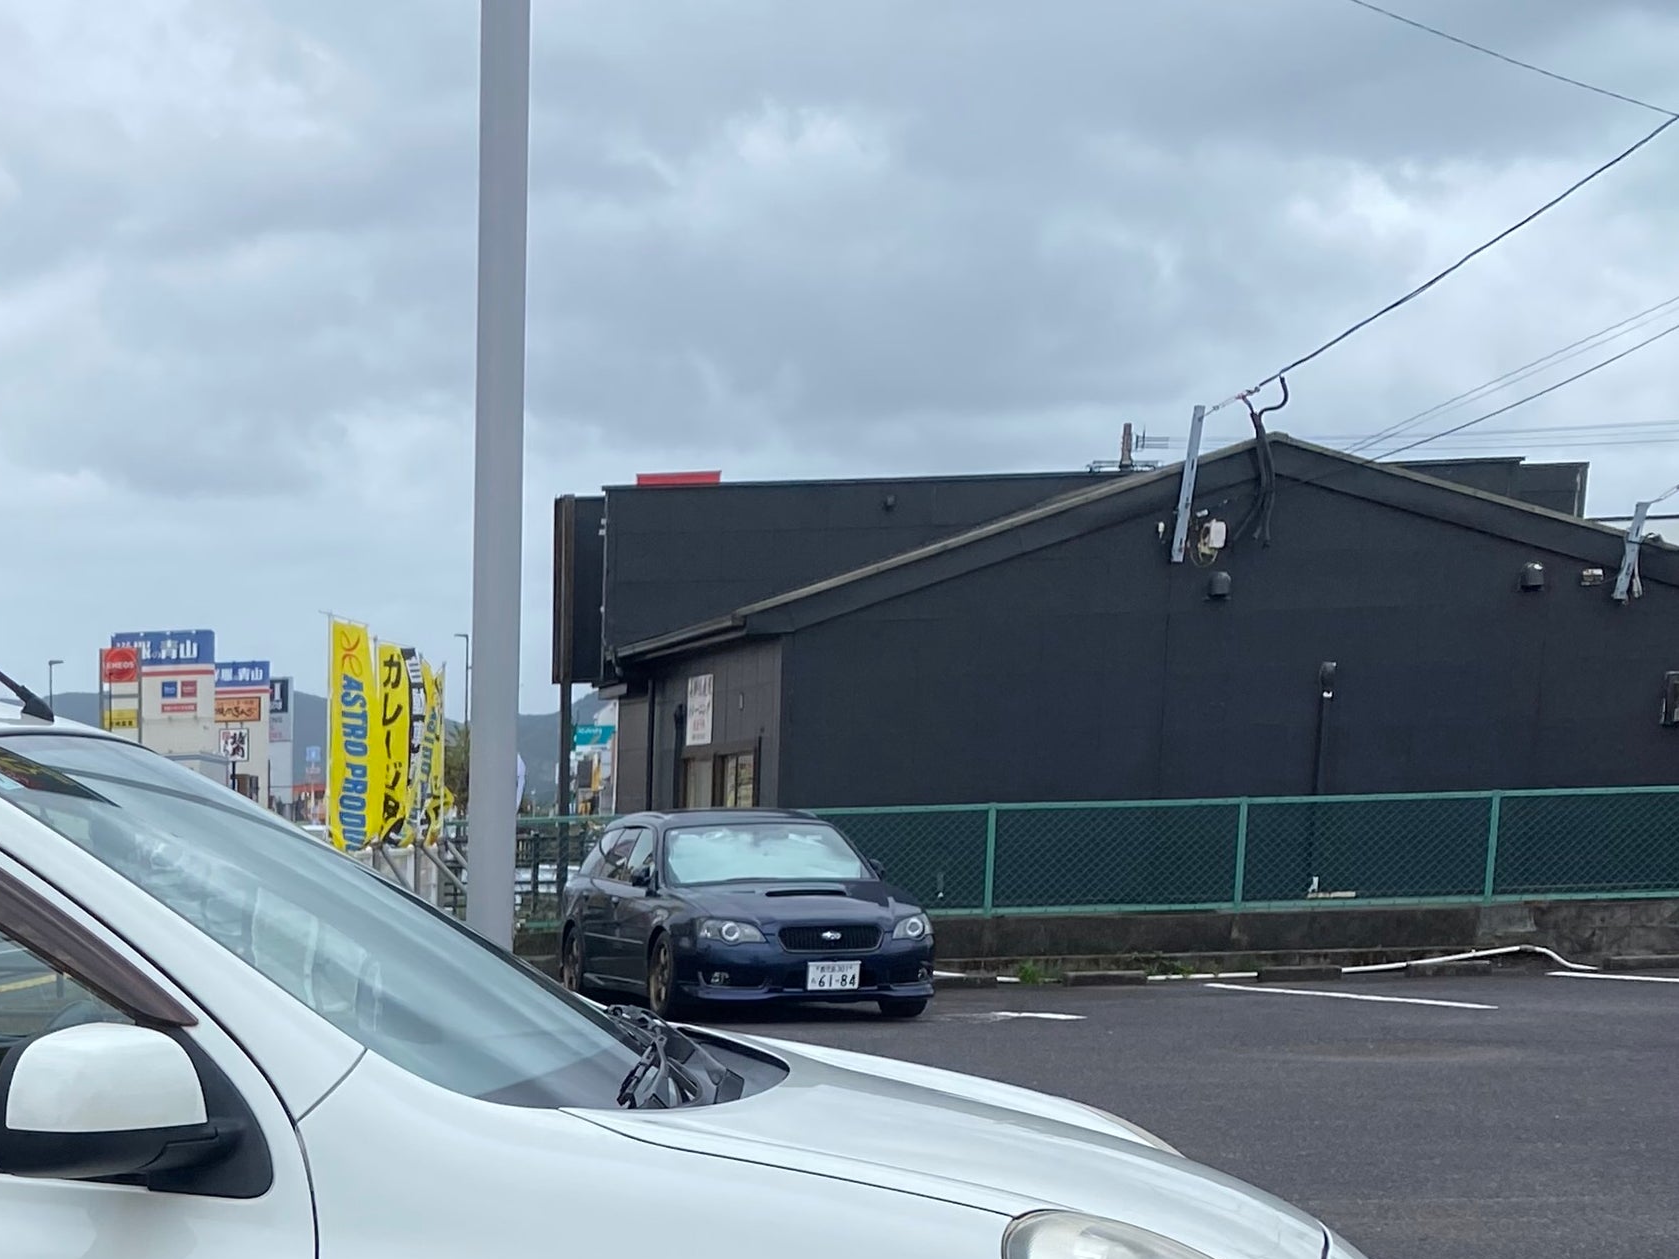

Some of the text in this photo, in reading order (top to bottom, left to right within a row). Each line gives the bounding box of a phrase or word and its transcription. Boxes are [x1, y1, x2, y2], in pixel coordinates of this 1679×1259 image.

[106, 660, 135, 670] ENEOS
[341, 674, 368, 757] ASTRO
[818, 973, 856, 987] 61-84
